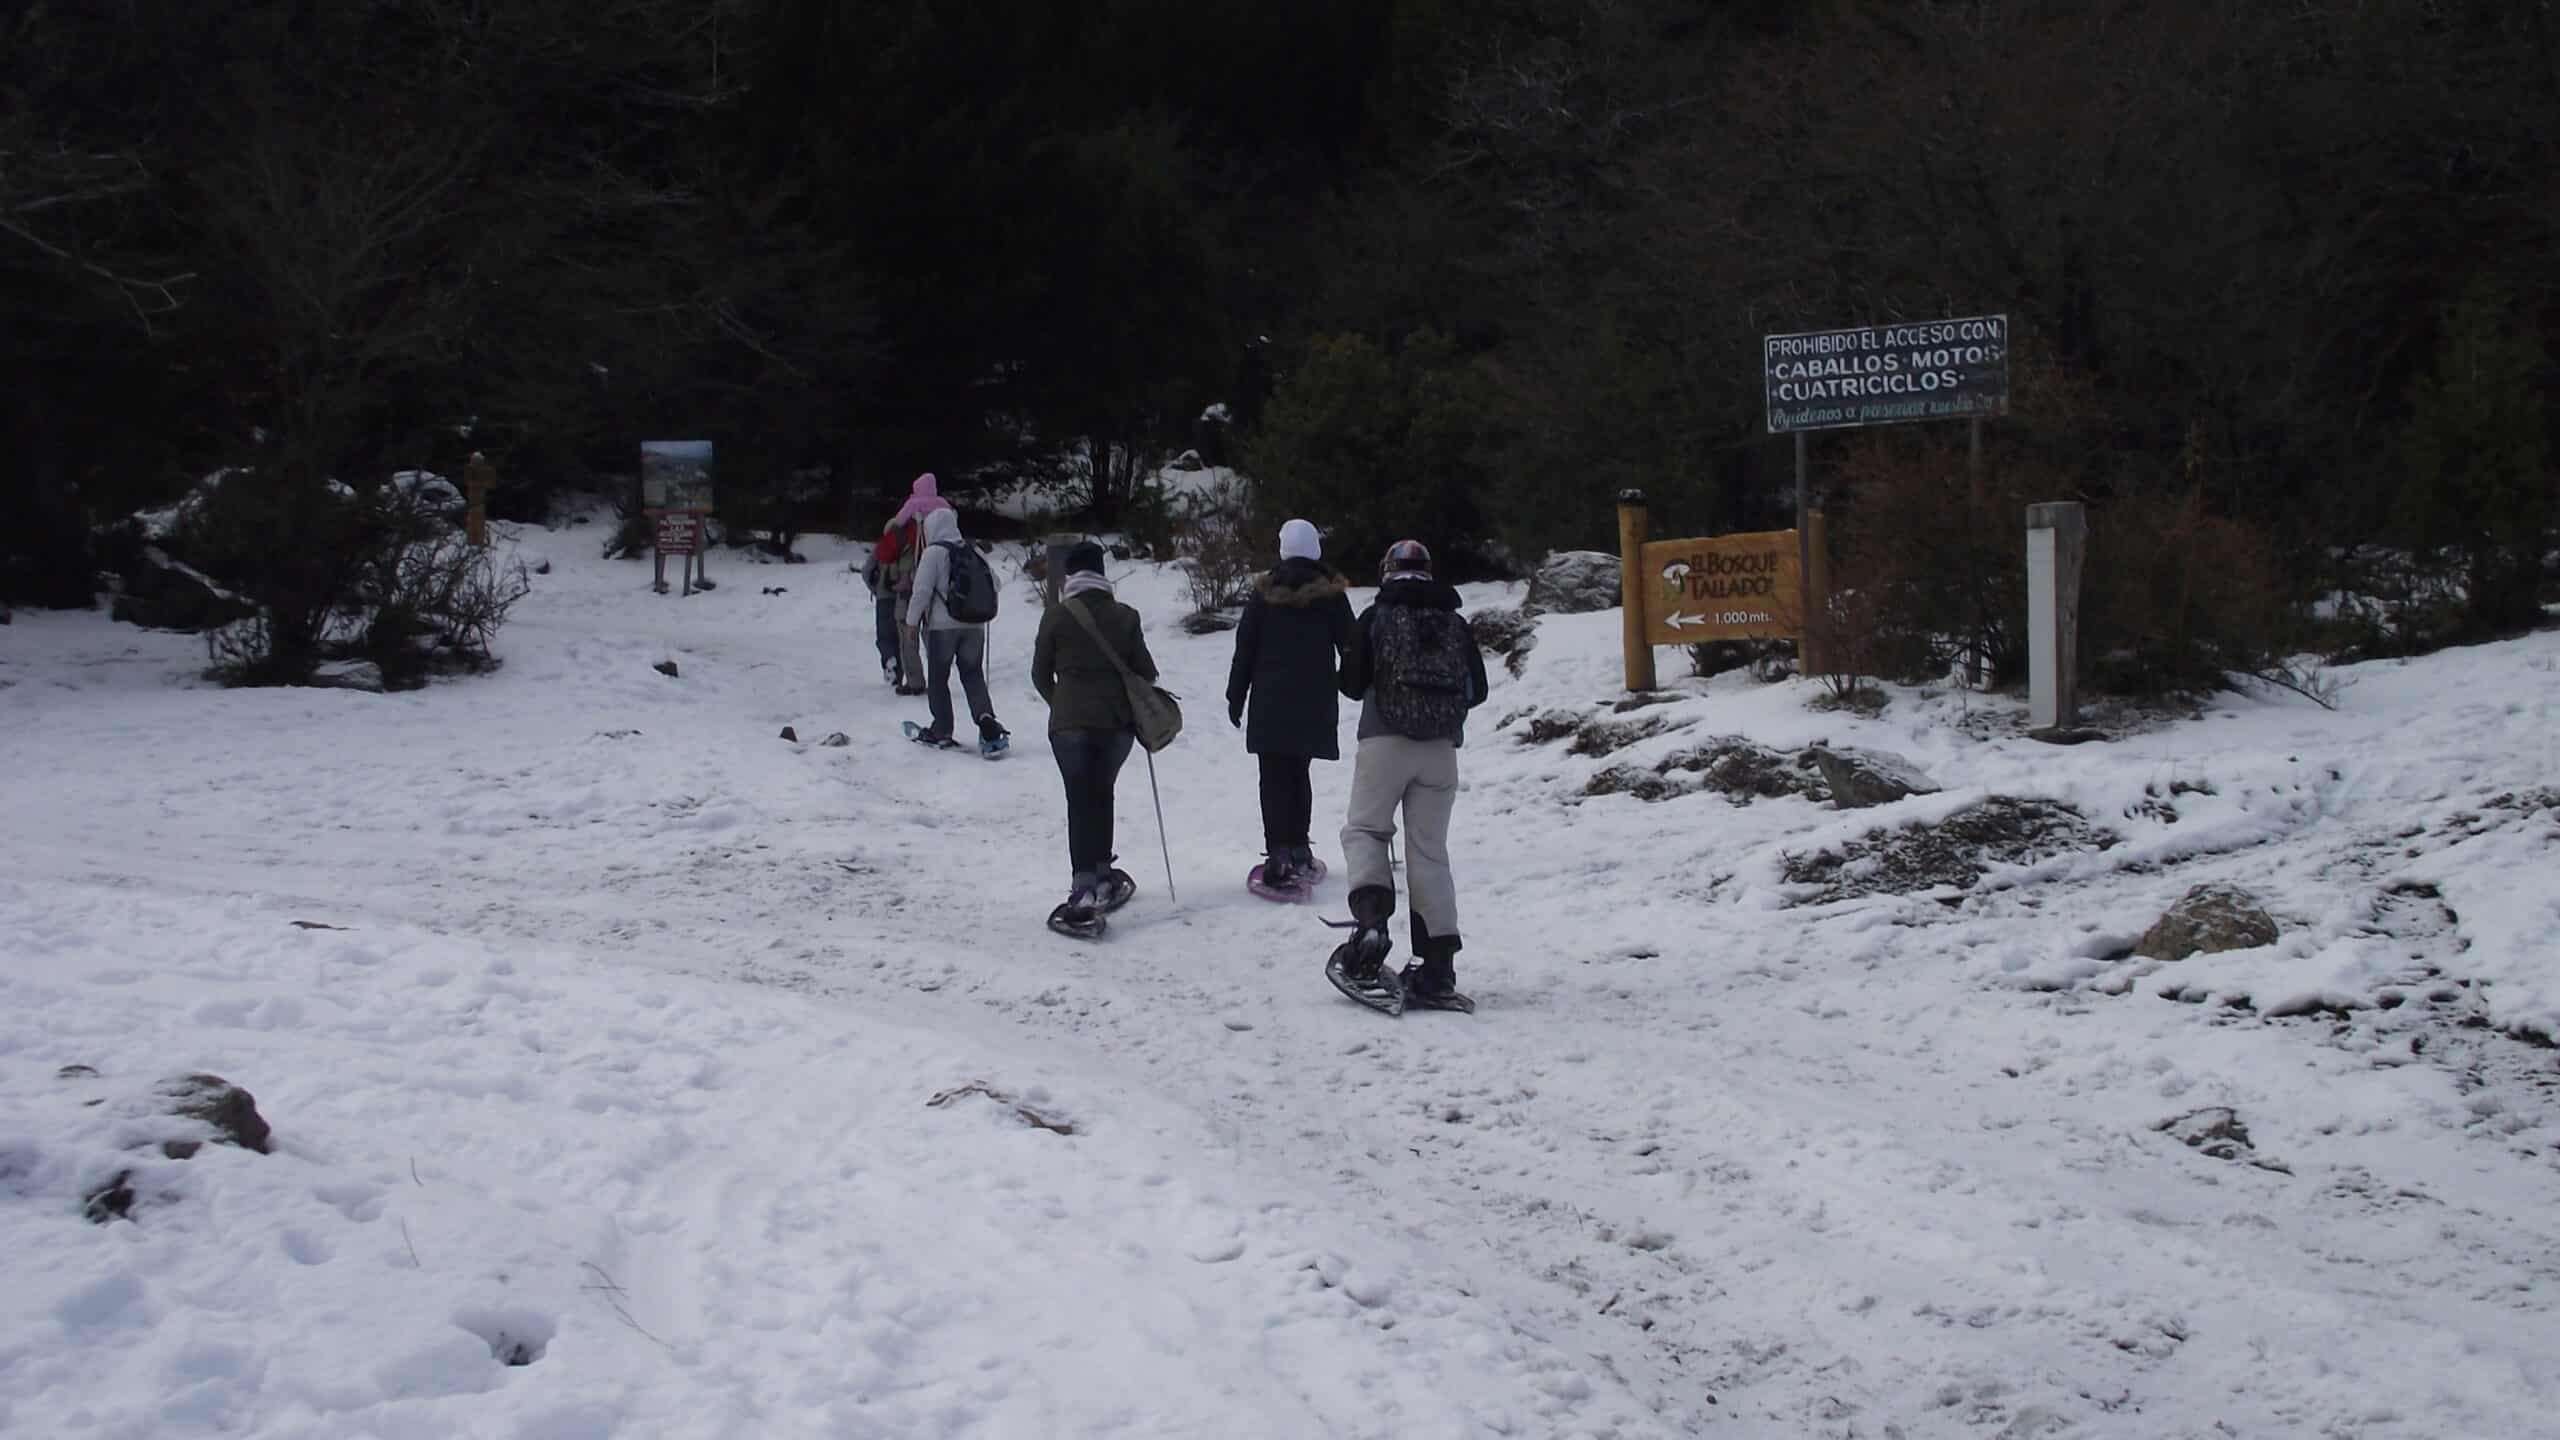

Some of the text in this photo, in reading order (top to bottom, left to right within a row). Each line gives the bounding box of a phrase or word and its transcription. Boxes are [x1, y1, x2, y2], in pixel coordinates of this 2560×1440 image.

[1769, 332, 1858, 358] PROHIBIDO
[1862, 328, 1880, 350] EL
[1885, 325, 1955, 348] ACCESO
[1775, 345, 2001, 380] CABALLOS MOTOS
[1779, 370, 1958, 401] CUATRICICLOS
[1707, 550, 1777, 575] BOSQUE
[1715, 610, 1747, 625] 1.000
